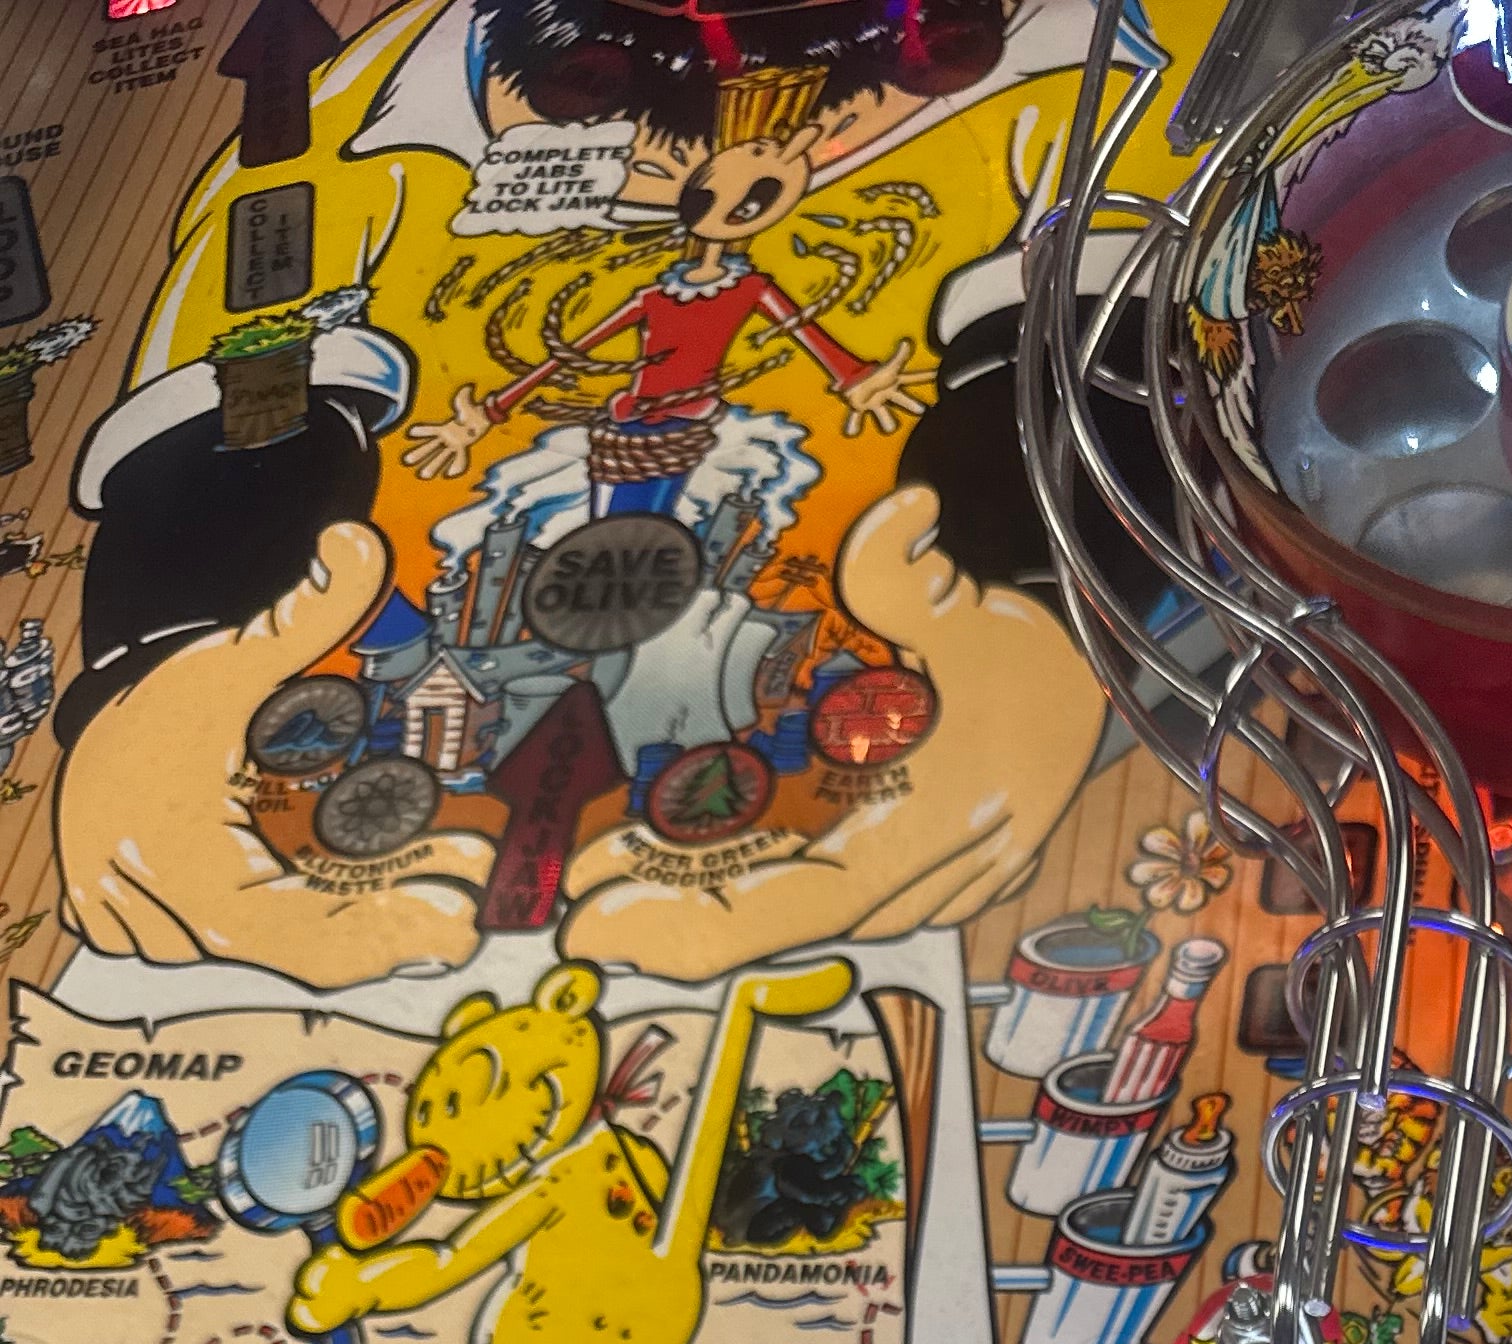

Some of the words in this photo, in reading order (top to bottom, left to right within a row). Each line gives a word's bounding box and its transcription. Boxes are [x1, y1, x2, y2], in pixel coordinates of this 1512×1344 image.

[112, 37, 184, 63] LITES
[88, 46, 205, 85] COLLECT
[113, 69, 177, 94] ITEM
[0, 141, 61, 167] USE
[485, 146, 627, 165] COMPLETE
[514, 164, 584, 180] JABS
[495, 182, 528, 196] TO
[537, 180, 597, 195] LITE
[470, 198, 541, 213] LOCK
[547, 195, 616, 211] JAW
[555, 547, 683, 580] SAVE
[536, 580, 690, 614] OLIVE
[702, 827, 790, 867] GREEN
[305, 875, 385, 896] WASTE
[632, 860, 745, 888] LOGGING
[53, 1051, 244, 1080] GEOMAP
[1050, 1108, 1139, 1137] WIMPY
[709, 1262, 889, 1286] PANDAMONIA
[1057, 1245, 1176, 1285] SWEE-PEA
[0, 1278, 139, 1297] PHRODESIA
